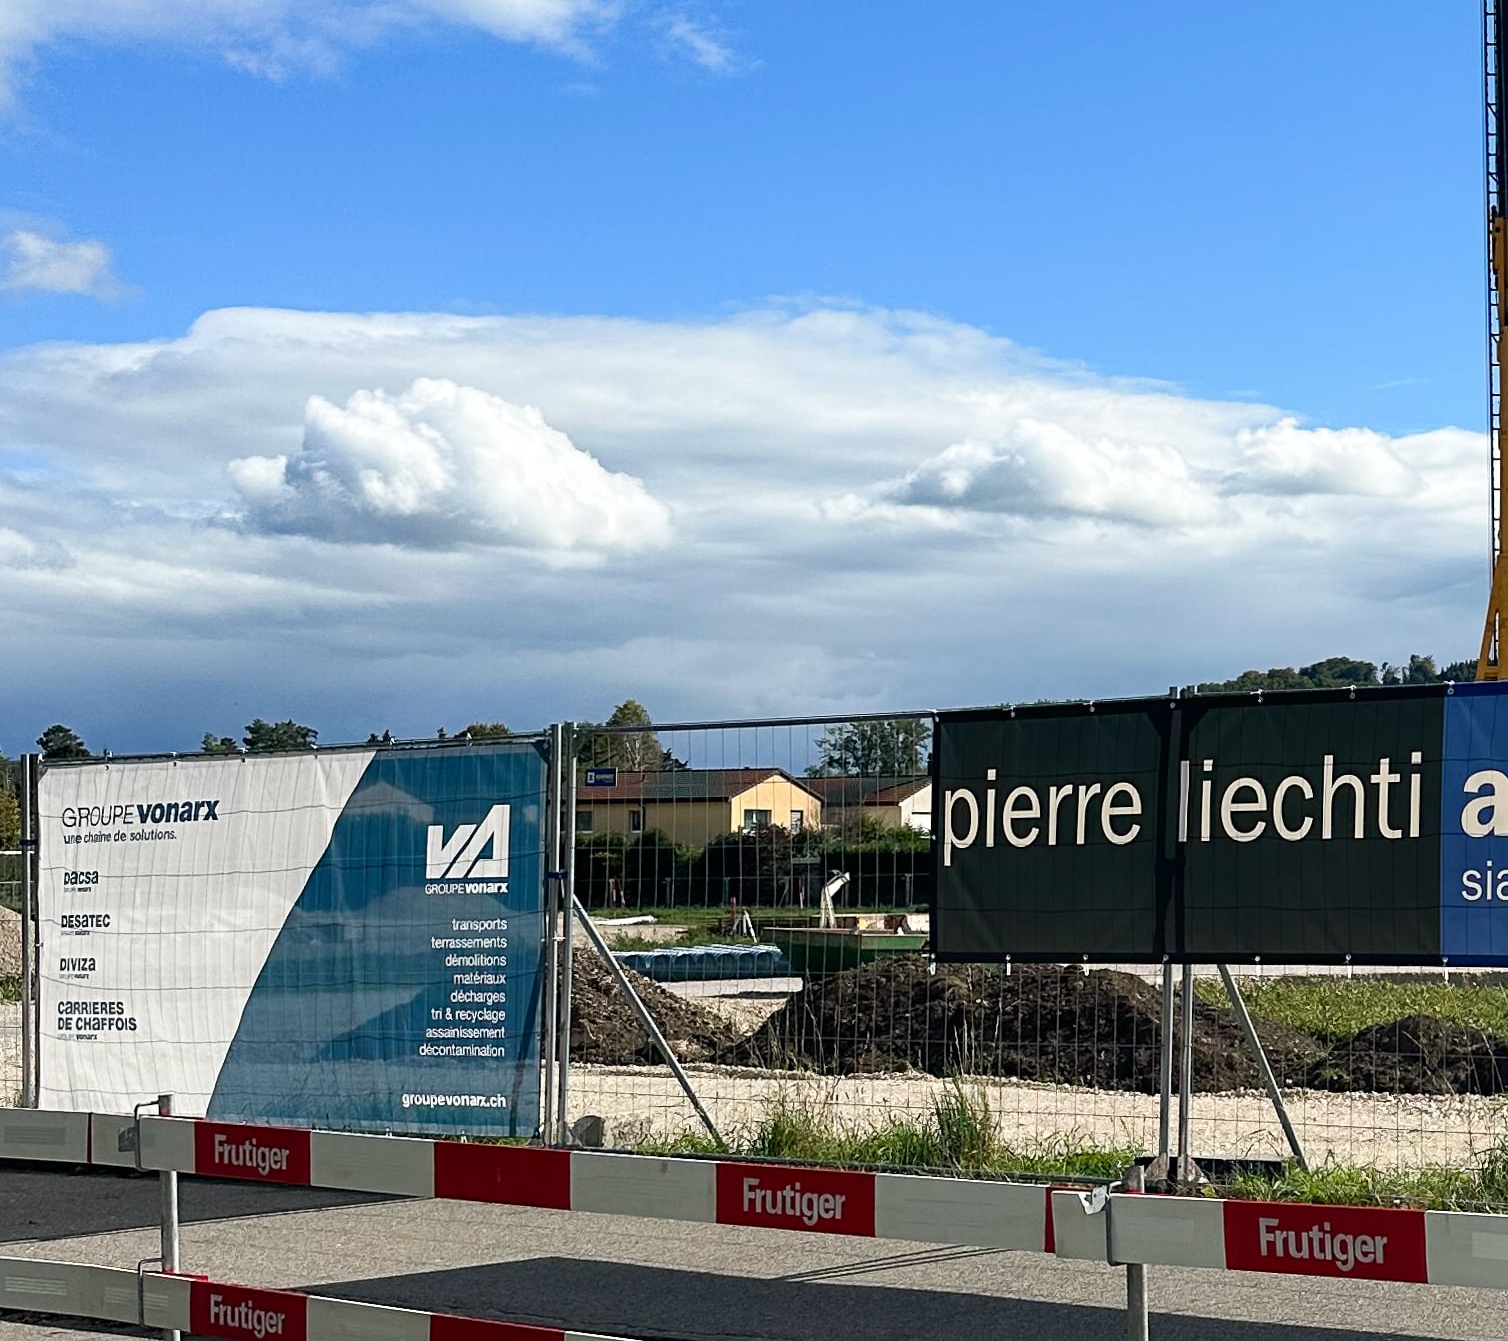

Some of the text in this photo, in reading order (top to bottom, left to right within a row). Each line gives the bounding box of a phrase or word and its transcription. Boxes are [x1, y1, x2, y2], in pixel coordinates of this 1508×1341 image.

[944, 769, 1140, 867] pierre
[1180, 752, 1420, 844] liechti
[64, 834, 82, 844] une
[114, 830, 126, 841] de
[130, 829, 177, 841] solutions.
[452, 918, 508, 933] transports
[431, 936, 507, 949] terrassements
[445, 954, 506, 967] démolitions
[454, 972, 506, 984] matériaux
[450, 990, 506, 1005] décharges
[431, 1008, 505, 1024] tri & recyclage
[58, 1018, 73, 1030] DE
[426, 1026, 505, 1039] assainissement
[419, 1044, 505, 1057] décontamination
[402, 1091, 506, 1108] groupevonarx.ch
[213, 1134, 290, 1176] Frutiger
[742, 1177, 845, 1226] Frutiger
[1259, 1218, 1388, 1273] Frutiger
[210, 1294, 286, 1337] Frutiger
